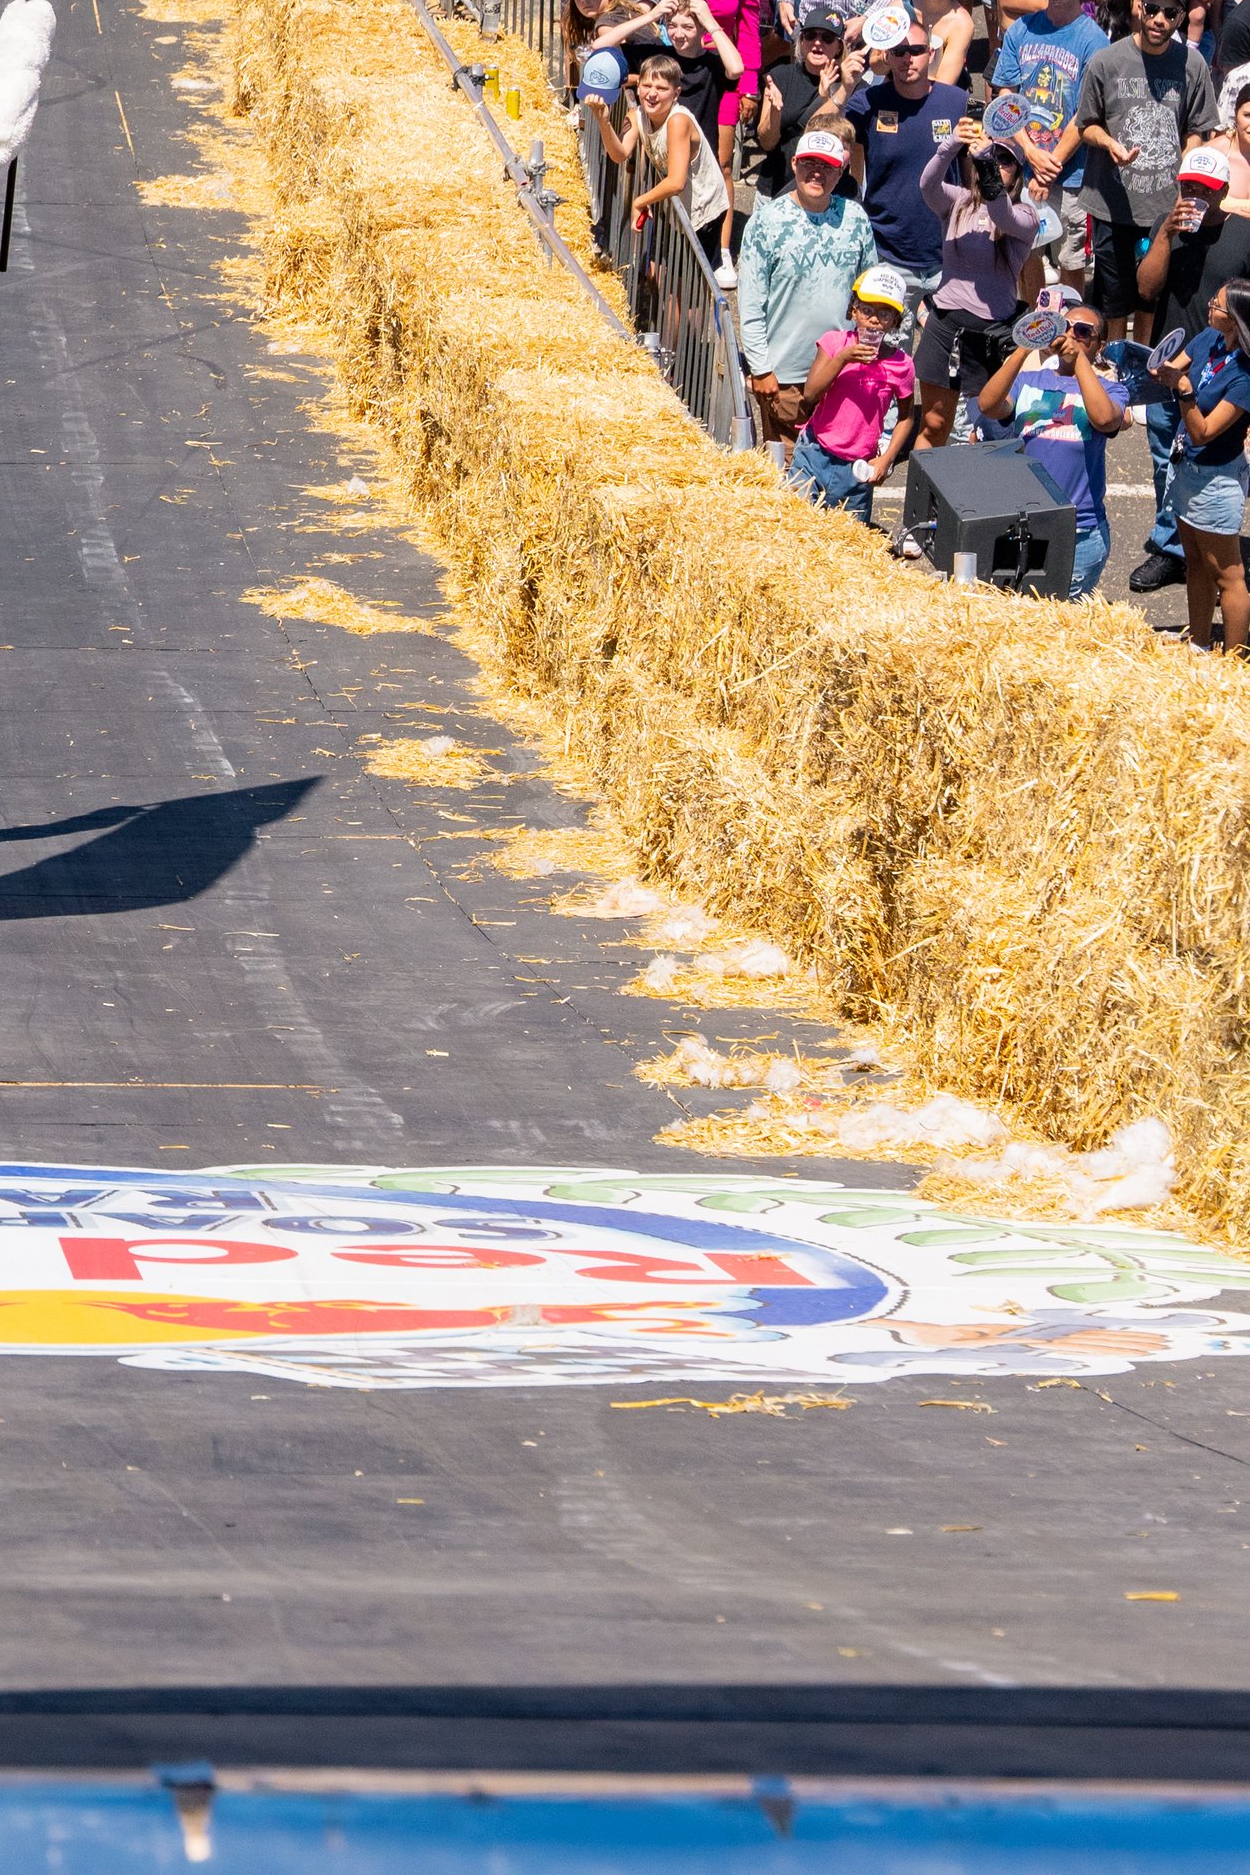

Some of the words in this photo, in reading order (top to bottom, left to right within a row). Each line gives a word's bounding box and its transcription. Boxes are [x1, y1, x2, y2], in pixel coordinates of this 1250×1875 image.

[1025, 327, 1040, 339] Red
[1038, 319, 1054, 333] Bull
[1157, 338, 1177, 363] 10
[60, 1237, 816, 1285] Red
